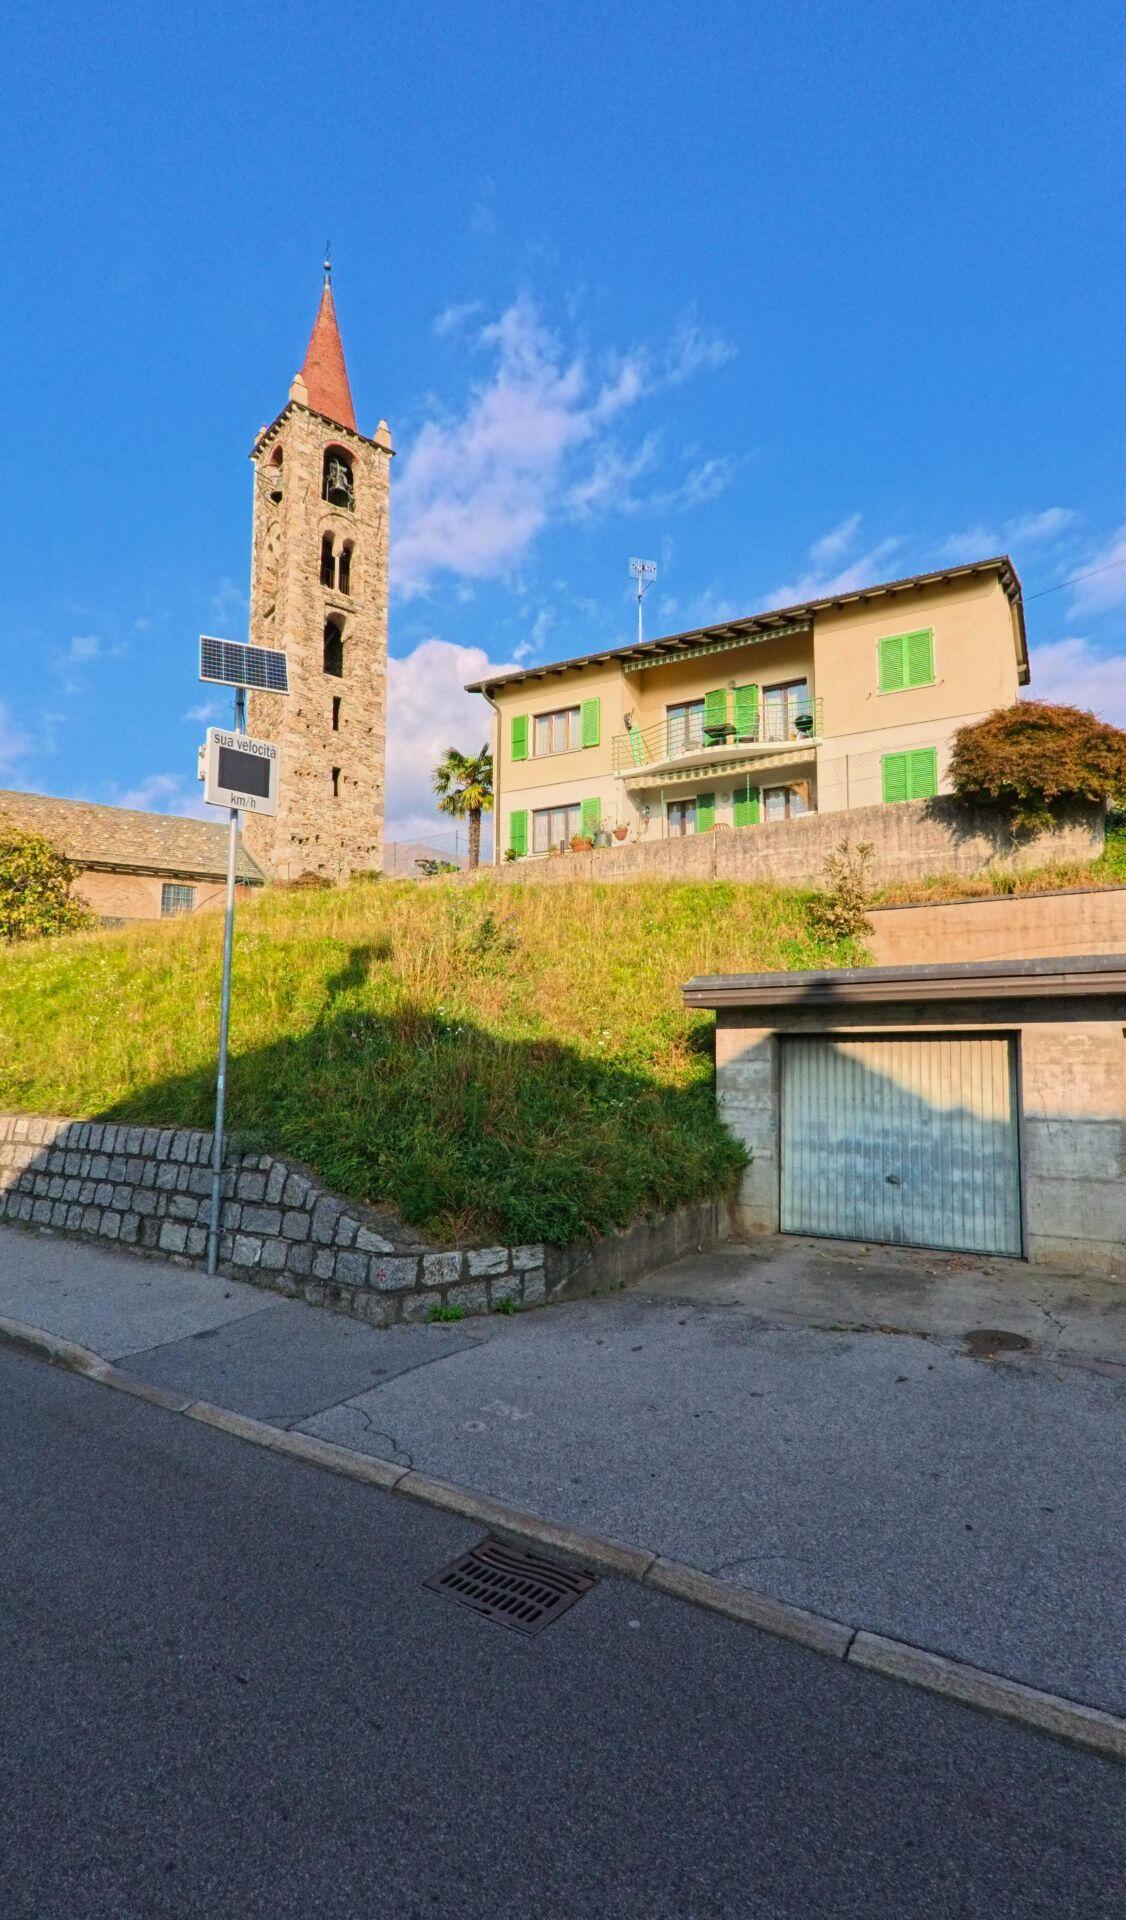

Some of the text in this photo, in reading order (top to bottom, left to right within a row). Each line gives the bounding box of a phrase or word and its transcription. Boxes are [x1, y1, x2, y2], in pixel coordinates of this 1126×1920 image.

[214, 733, 277, 759] sua velocità
[230, 793, 256, 808] km/h
